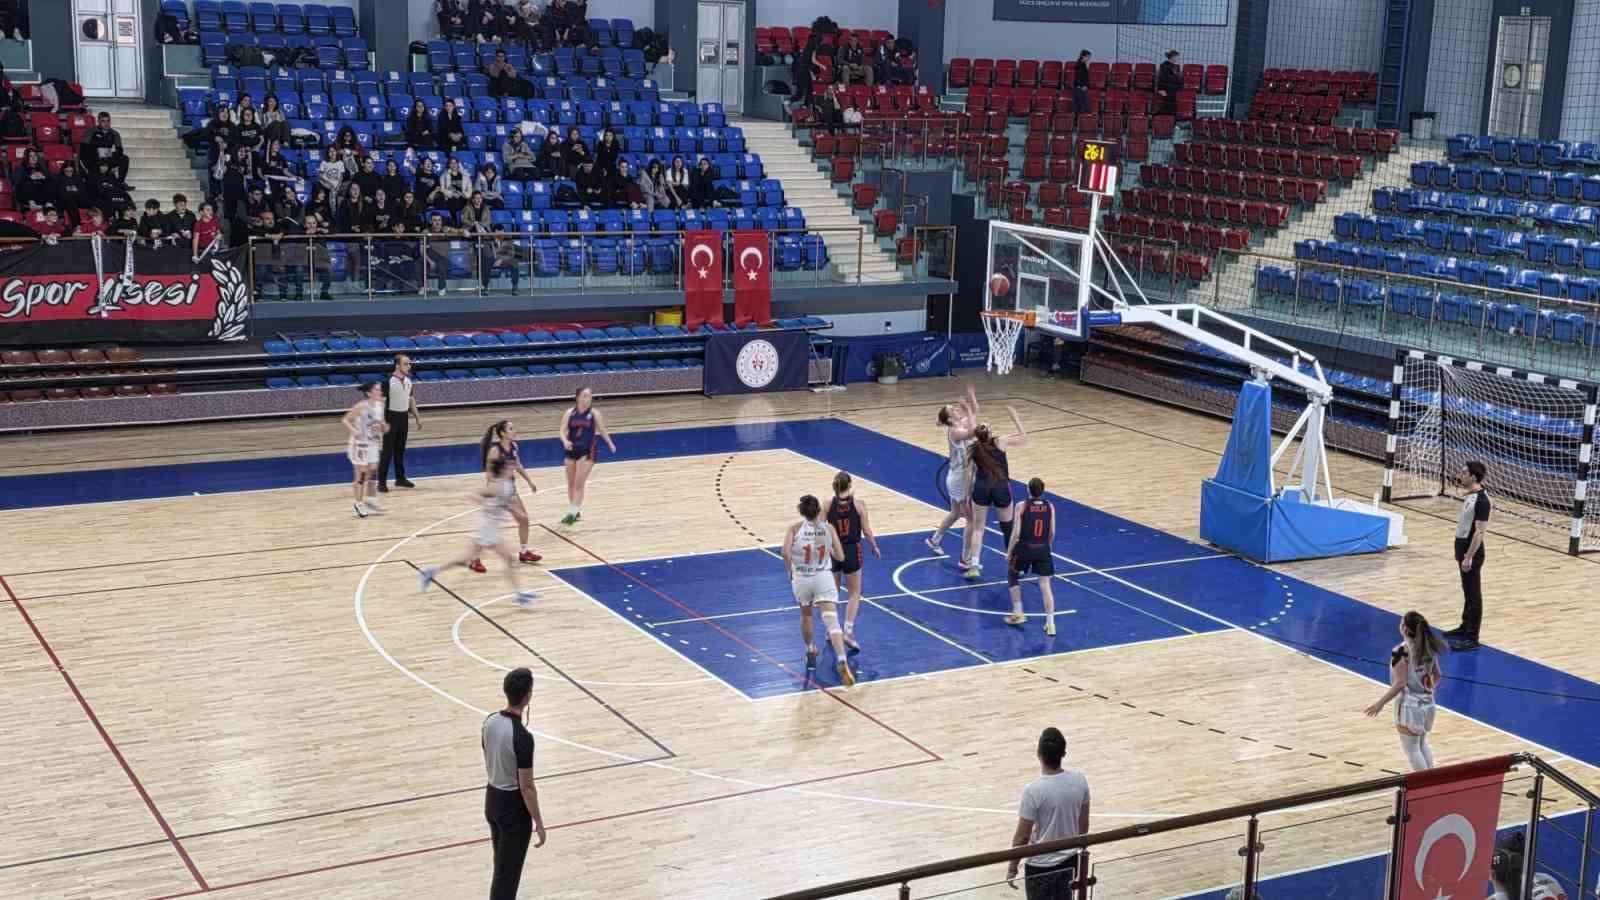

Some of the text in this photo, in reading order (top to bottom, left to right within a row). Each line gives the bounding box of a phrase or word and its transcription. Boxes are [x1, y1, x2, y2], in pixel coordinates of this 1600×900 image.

[0, 273, 200, 318] Spor Lisesi
[802, 543, 826, 565] 11
